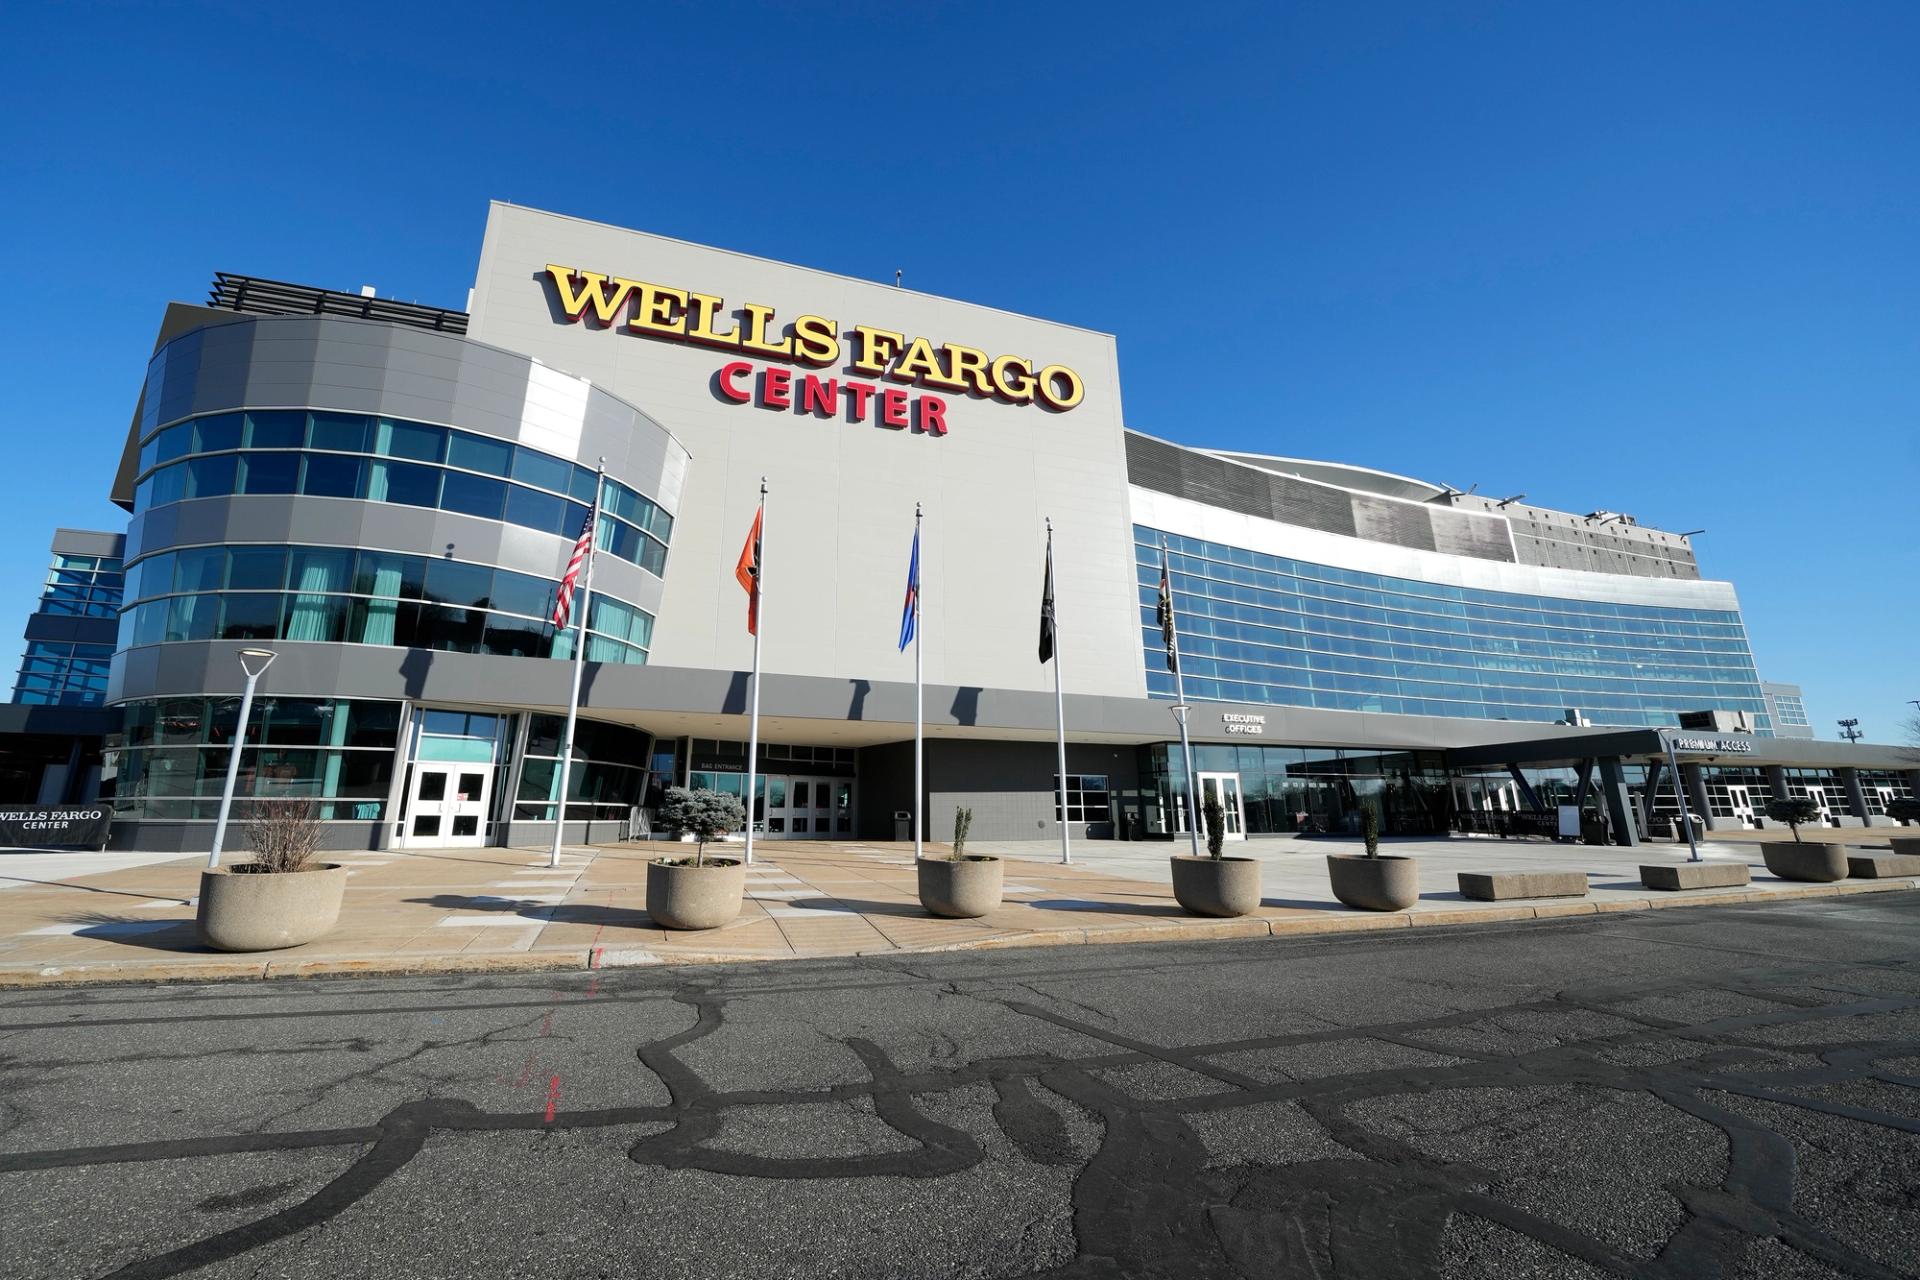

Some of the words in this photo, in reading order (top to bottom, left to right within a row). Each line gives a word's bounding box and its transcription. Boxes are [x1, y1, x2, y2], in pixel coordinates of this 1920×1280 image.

[545, 264, 840, 368] WELLS
[855, 325, 1085, 412] FARGO
[719, 361, 948, 435] CENTER
[1223, 713, 1266, 724] EXECUTIVE
[1229, 724, 1263, 734] OFFICES
[1678, 738, 1719, 750] PREMIUM
[1720, 740, 1752, 752] ACCESS
[49, 810, 102, 820] FARGO
[22, 821, 69, 829] CENTER
